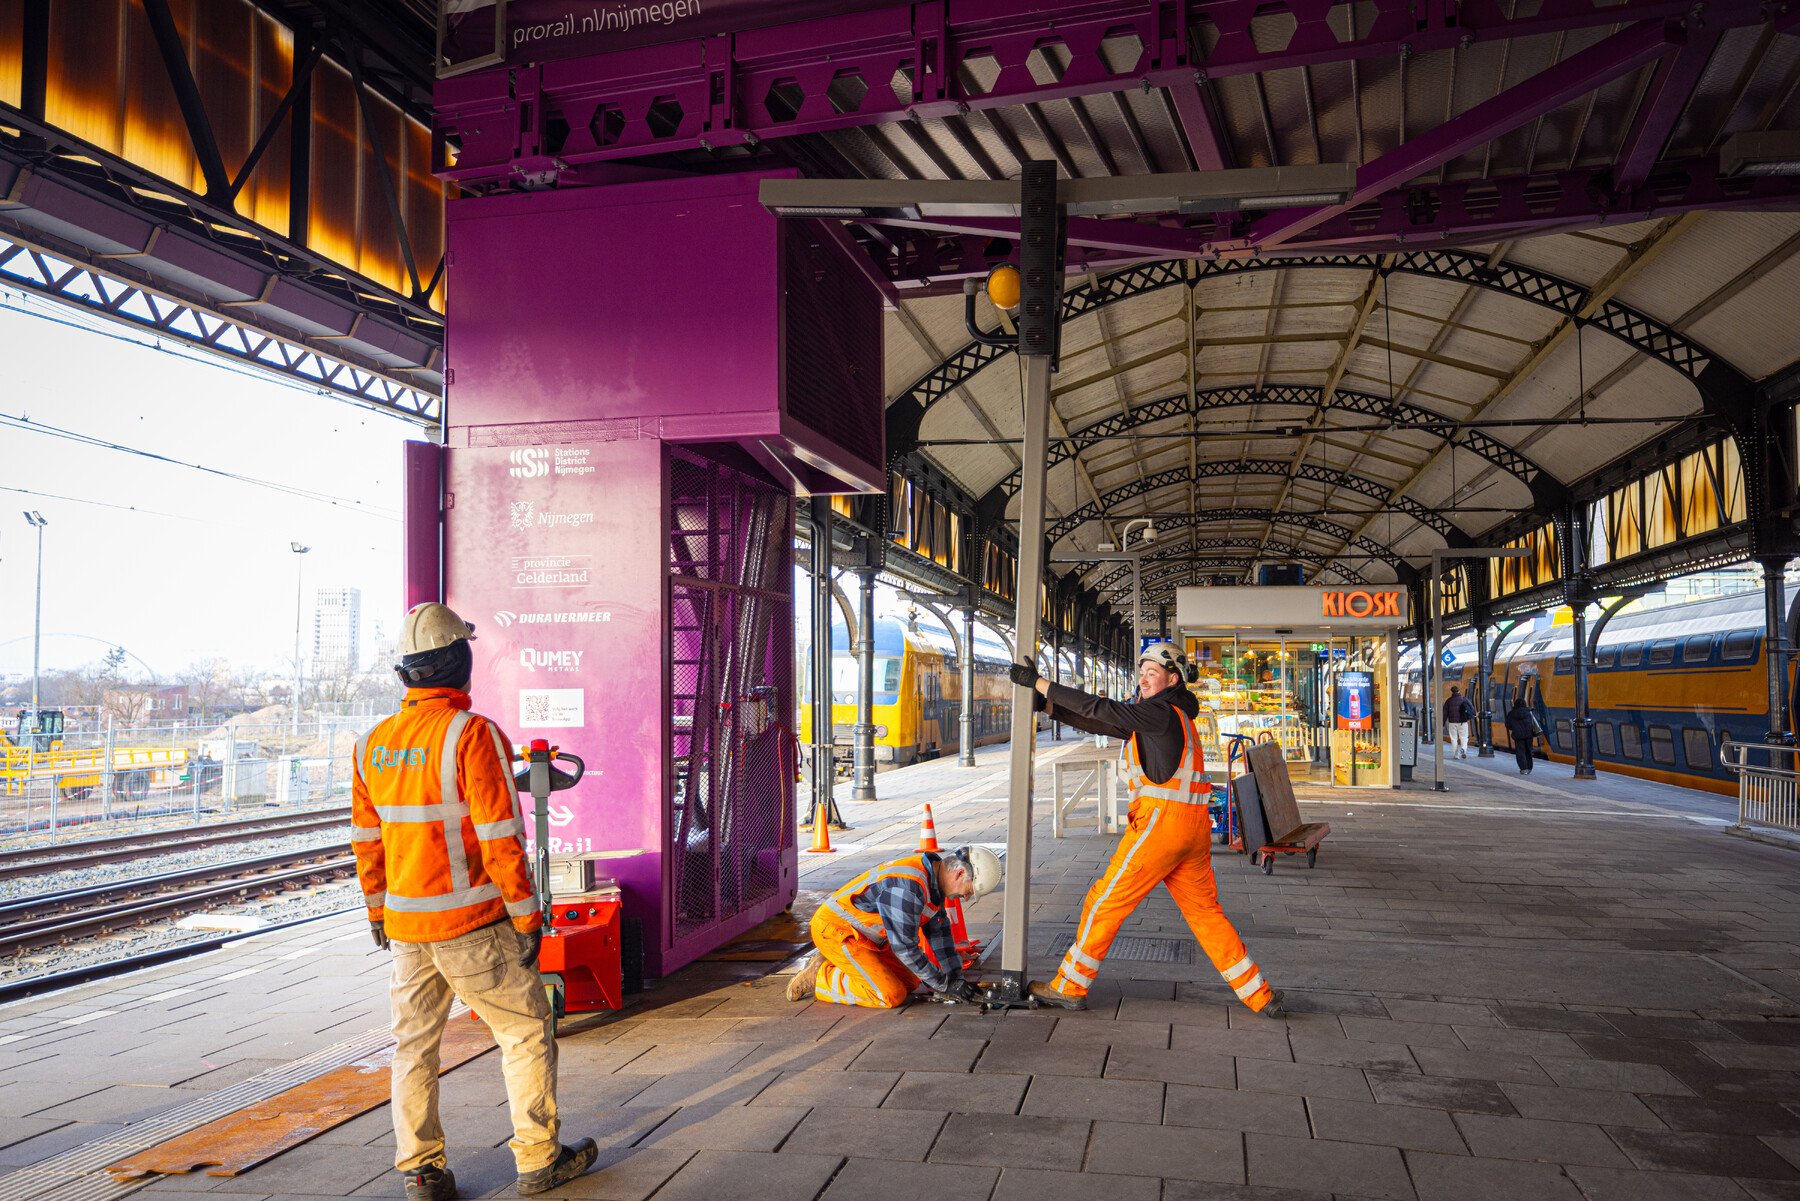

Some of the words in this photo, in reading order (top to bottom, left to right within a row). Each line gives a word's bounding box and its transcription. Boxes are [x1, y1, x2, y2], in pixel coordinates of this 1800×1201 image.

[513, 0, 702, 49] prorail.nl/nijmegen
[554, 447, 591, 457] Stations
[554, 456, 587, 465] District
[554, 465, 595, 476] Nijmegen
[537, 511, 594, 527] Nijmegen
[523, 557, 572, 570] provincie
[516, 570, 588, 584] Gelderland
[1322, 590, 1400, 618] KIOSK
[518, 613, 552, 624] DURA
[553, 611, 611, 623] VERMEER
[519, 647, 584, 672] QUMEY
[1444, 653, 1451, 662] 6
[371, 745, 430, 773] QUMEY
